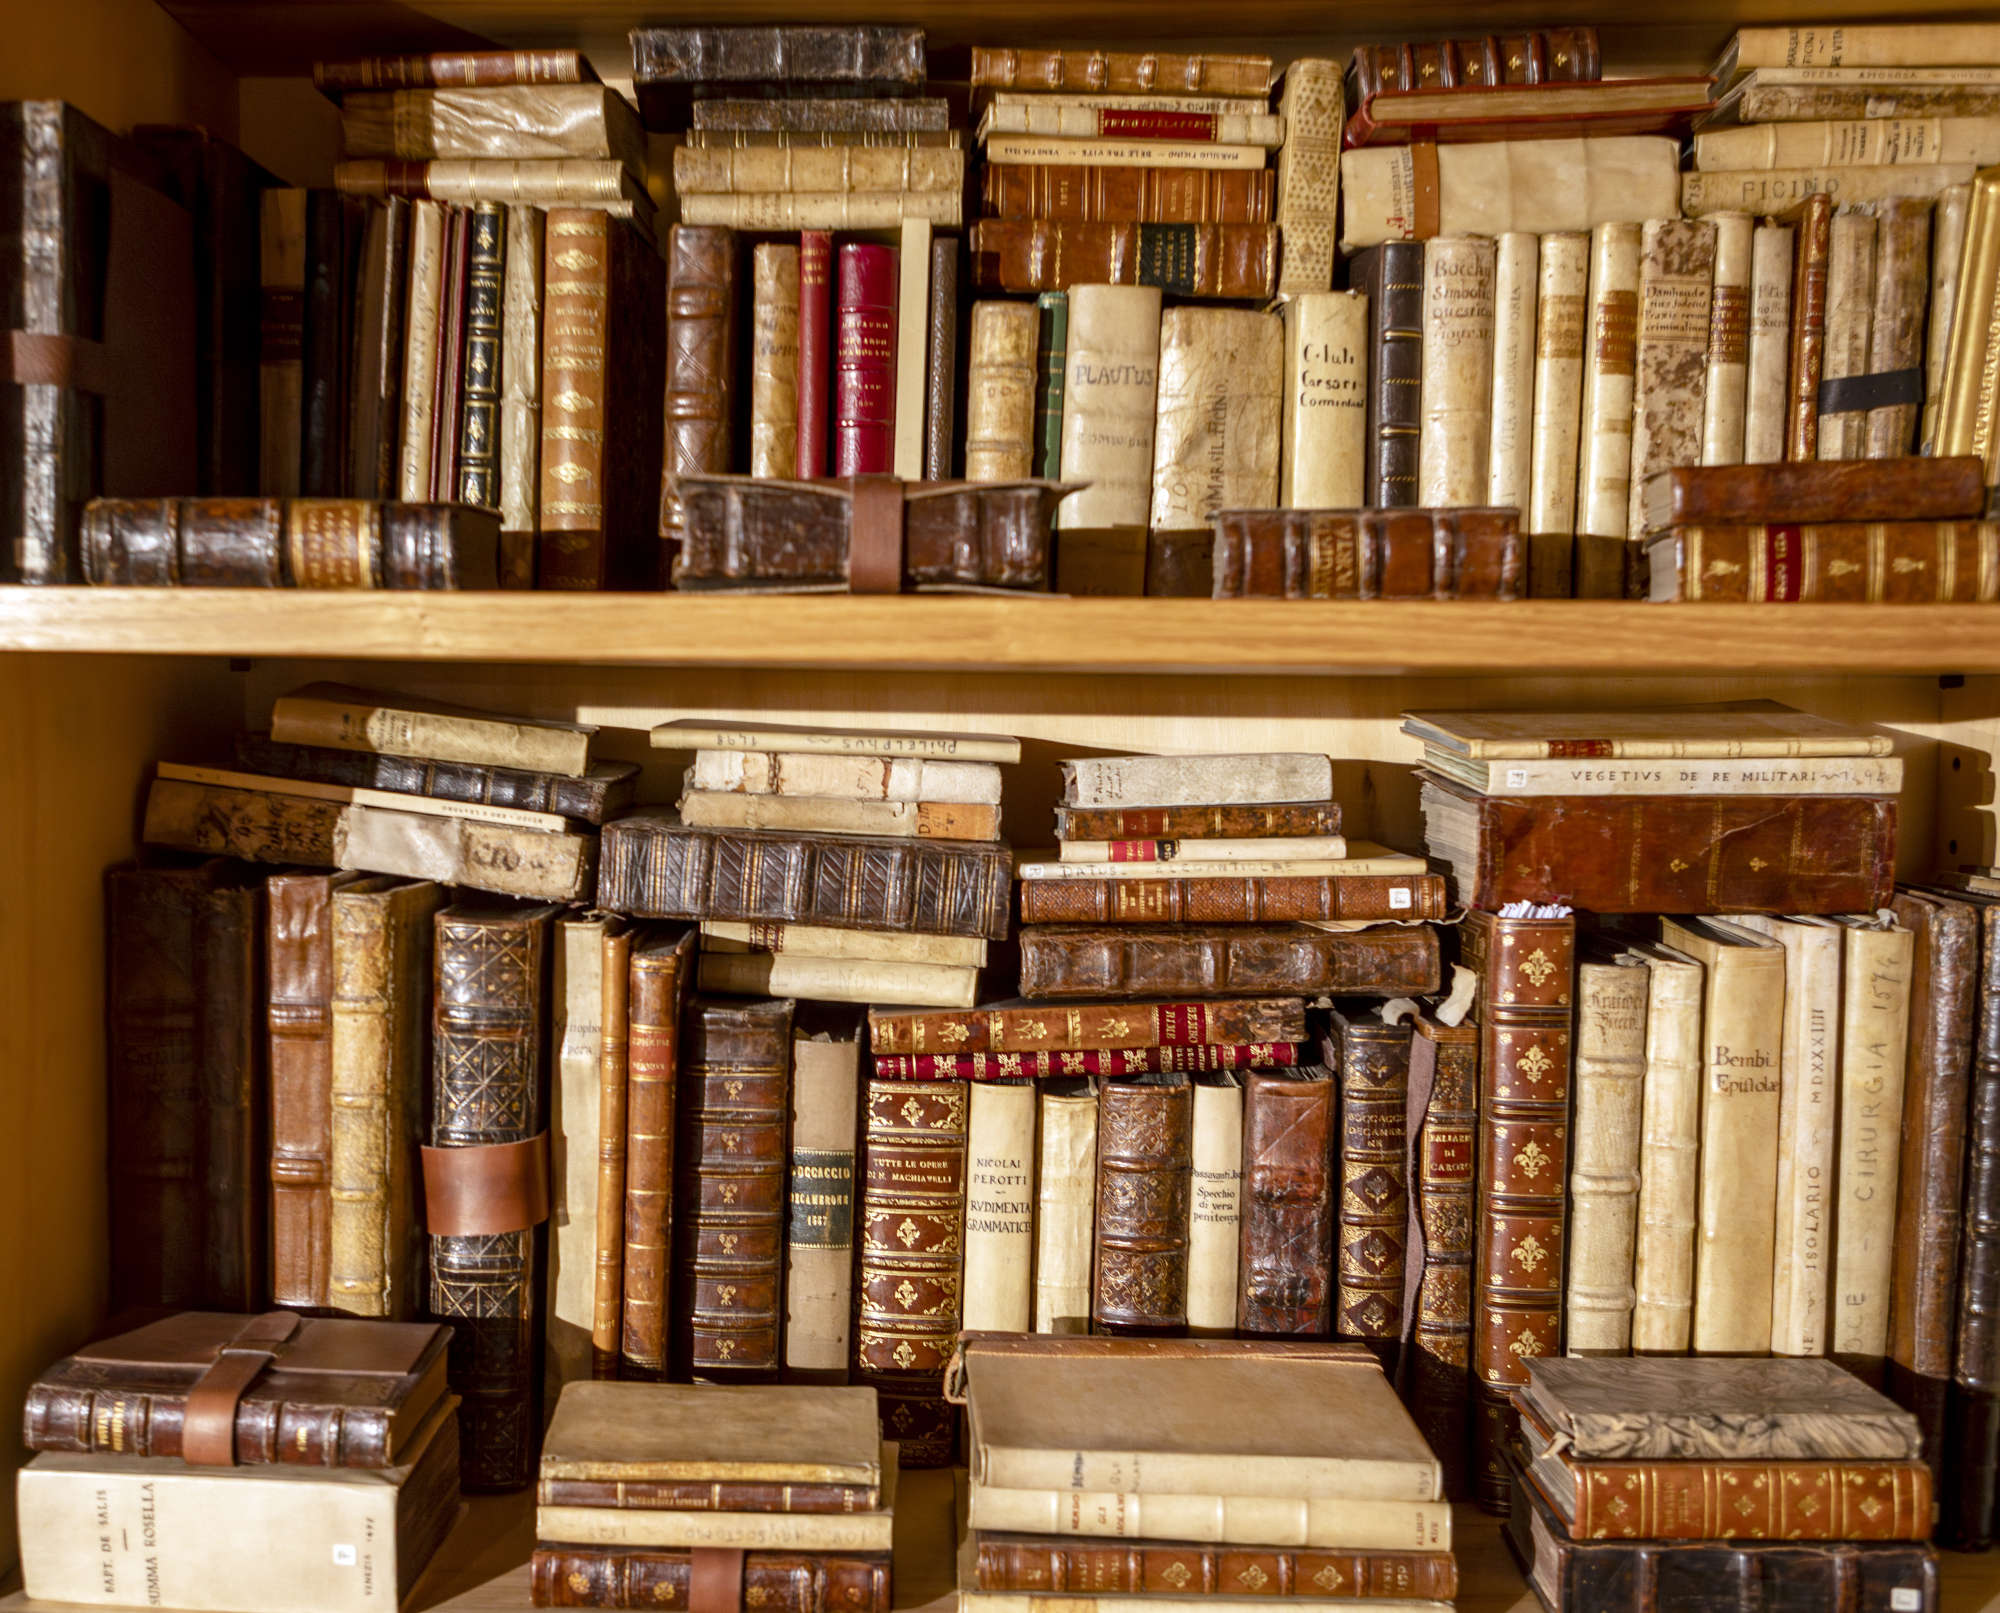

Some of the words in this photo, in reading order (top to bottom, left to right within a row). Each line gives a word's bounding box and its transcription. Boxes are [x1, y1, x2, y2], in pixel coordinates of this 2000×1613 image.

[1074, 364, 1157, 387] PLAUTUS
[1571, 769, 1662, 783] VEGETIVS
[1679, 771, 1699, 783] DE
[1711, 771, 1731, 783] RE
[1741, 771, 1818, 783] MILITARI
[1165, 1009, 1177, 1040] RIME
[1186, 1005, 1199, 1044] BEMBO
[1714, 1045, 1774, 1069] Bembi
[1852, 1039, 1889, 1203] CIRURGIA
[873, 1157, 902, 1168] TUTTE
[905, 1159, 917, 1169] LE
[919, 1160, 949, 1170] OPERE
[976, 1157, 1022, 1169] NICOLAI
[891, 1173, 953, 1184] MACHIAVELLI
[973, 1173, 1028, 1187] PEROTTI
[1196, 1185, 1236, 1200] Specchio
[970, 1199, 1032, 1215] RVDIMENTA
[1211, 1202, 1233, 1211] vera
[1806, 1165, 1822, 1271] ISOLARIO
[95, 1488, 110, 1527] SALIS
[139, 1482, 157, 1549] ROSELLA
[100, 1534, 113, 1554] DE
[144, 1555, 162, 1608] SUMMA
